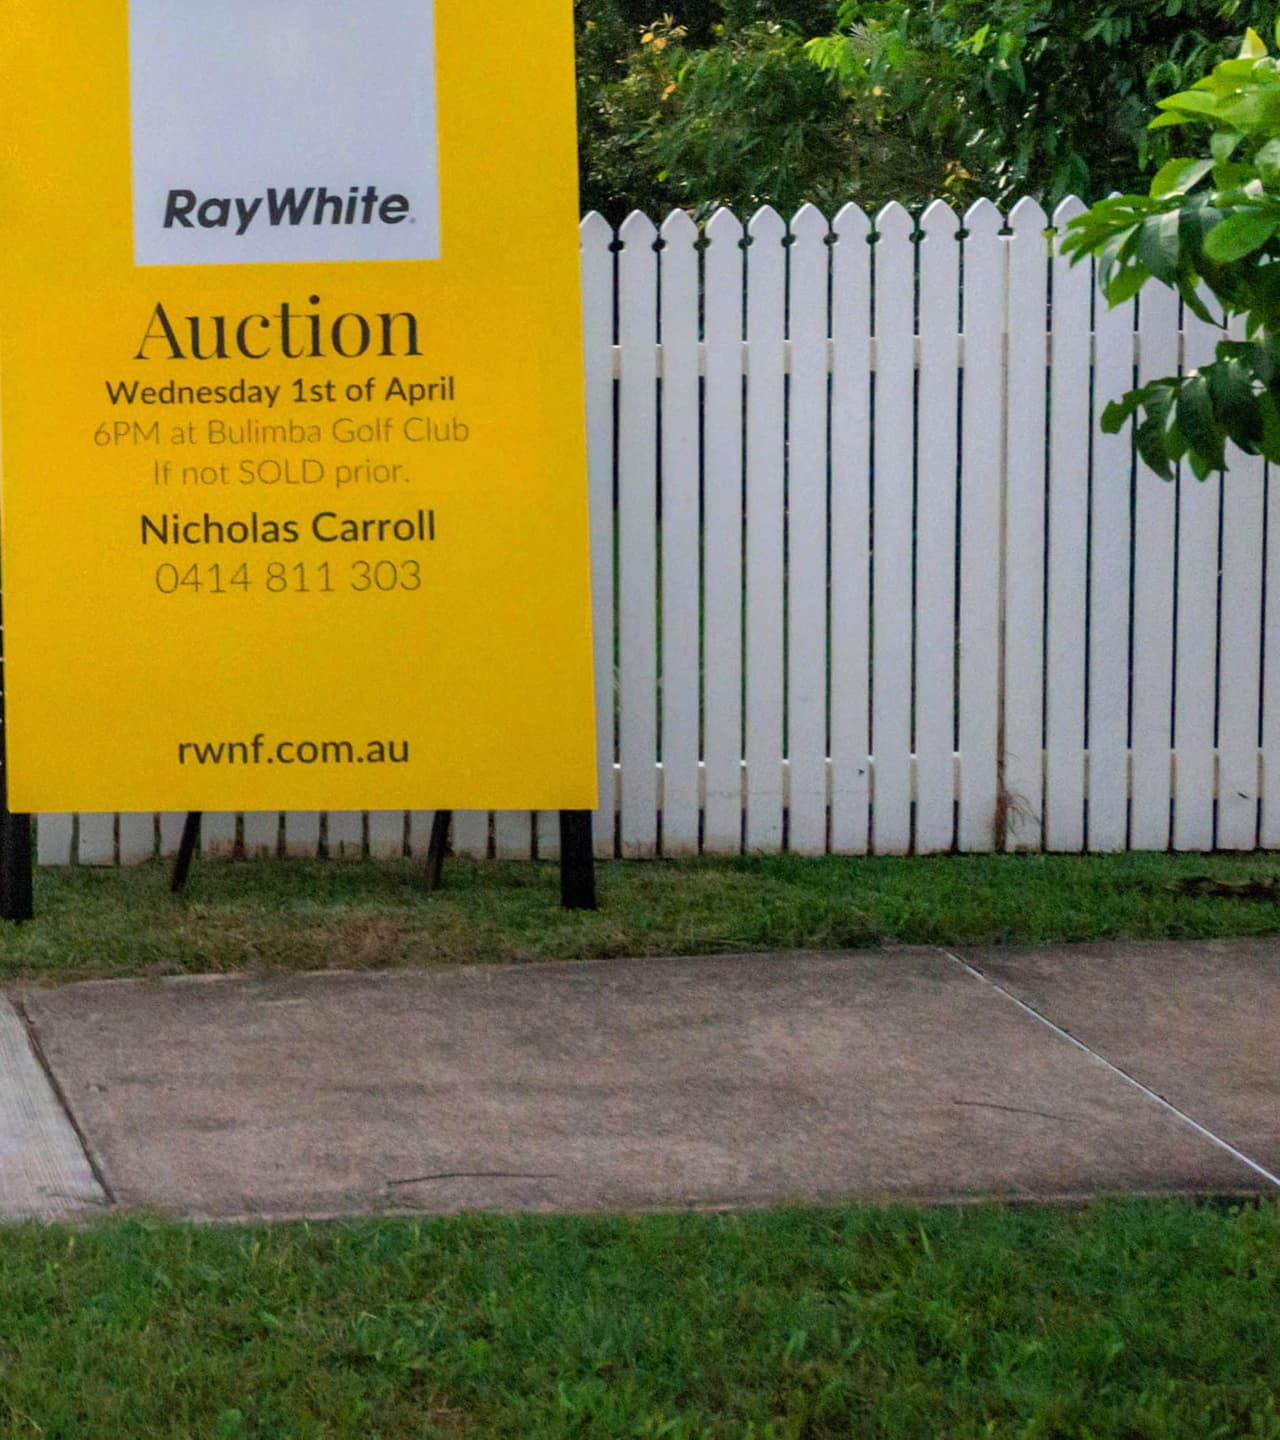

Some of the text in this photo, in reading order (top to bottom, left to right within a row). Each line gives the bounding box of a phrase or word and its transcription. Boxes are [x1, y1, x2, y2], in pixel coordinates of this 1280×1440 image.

[135, 294, 423, 360] Auction
[105, 375, 454, 408] Wednesday 1st of April
[93, 415, 470, 447] 6PM at Bulimba Golf Club
[154, 458, 410, 488] If not SOLD prior.
[140, 509, 436, 545] Nicholas Carroll
[155, 560, 422, 594] 0414 811 303
[178, 733, 410, 765] rwnf.com.au
